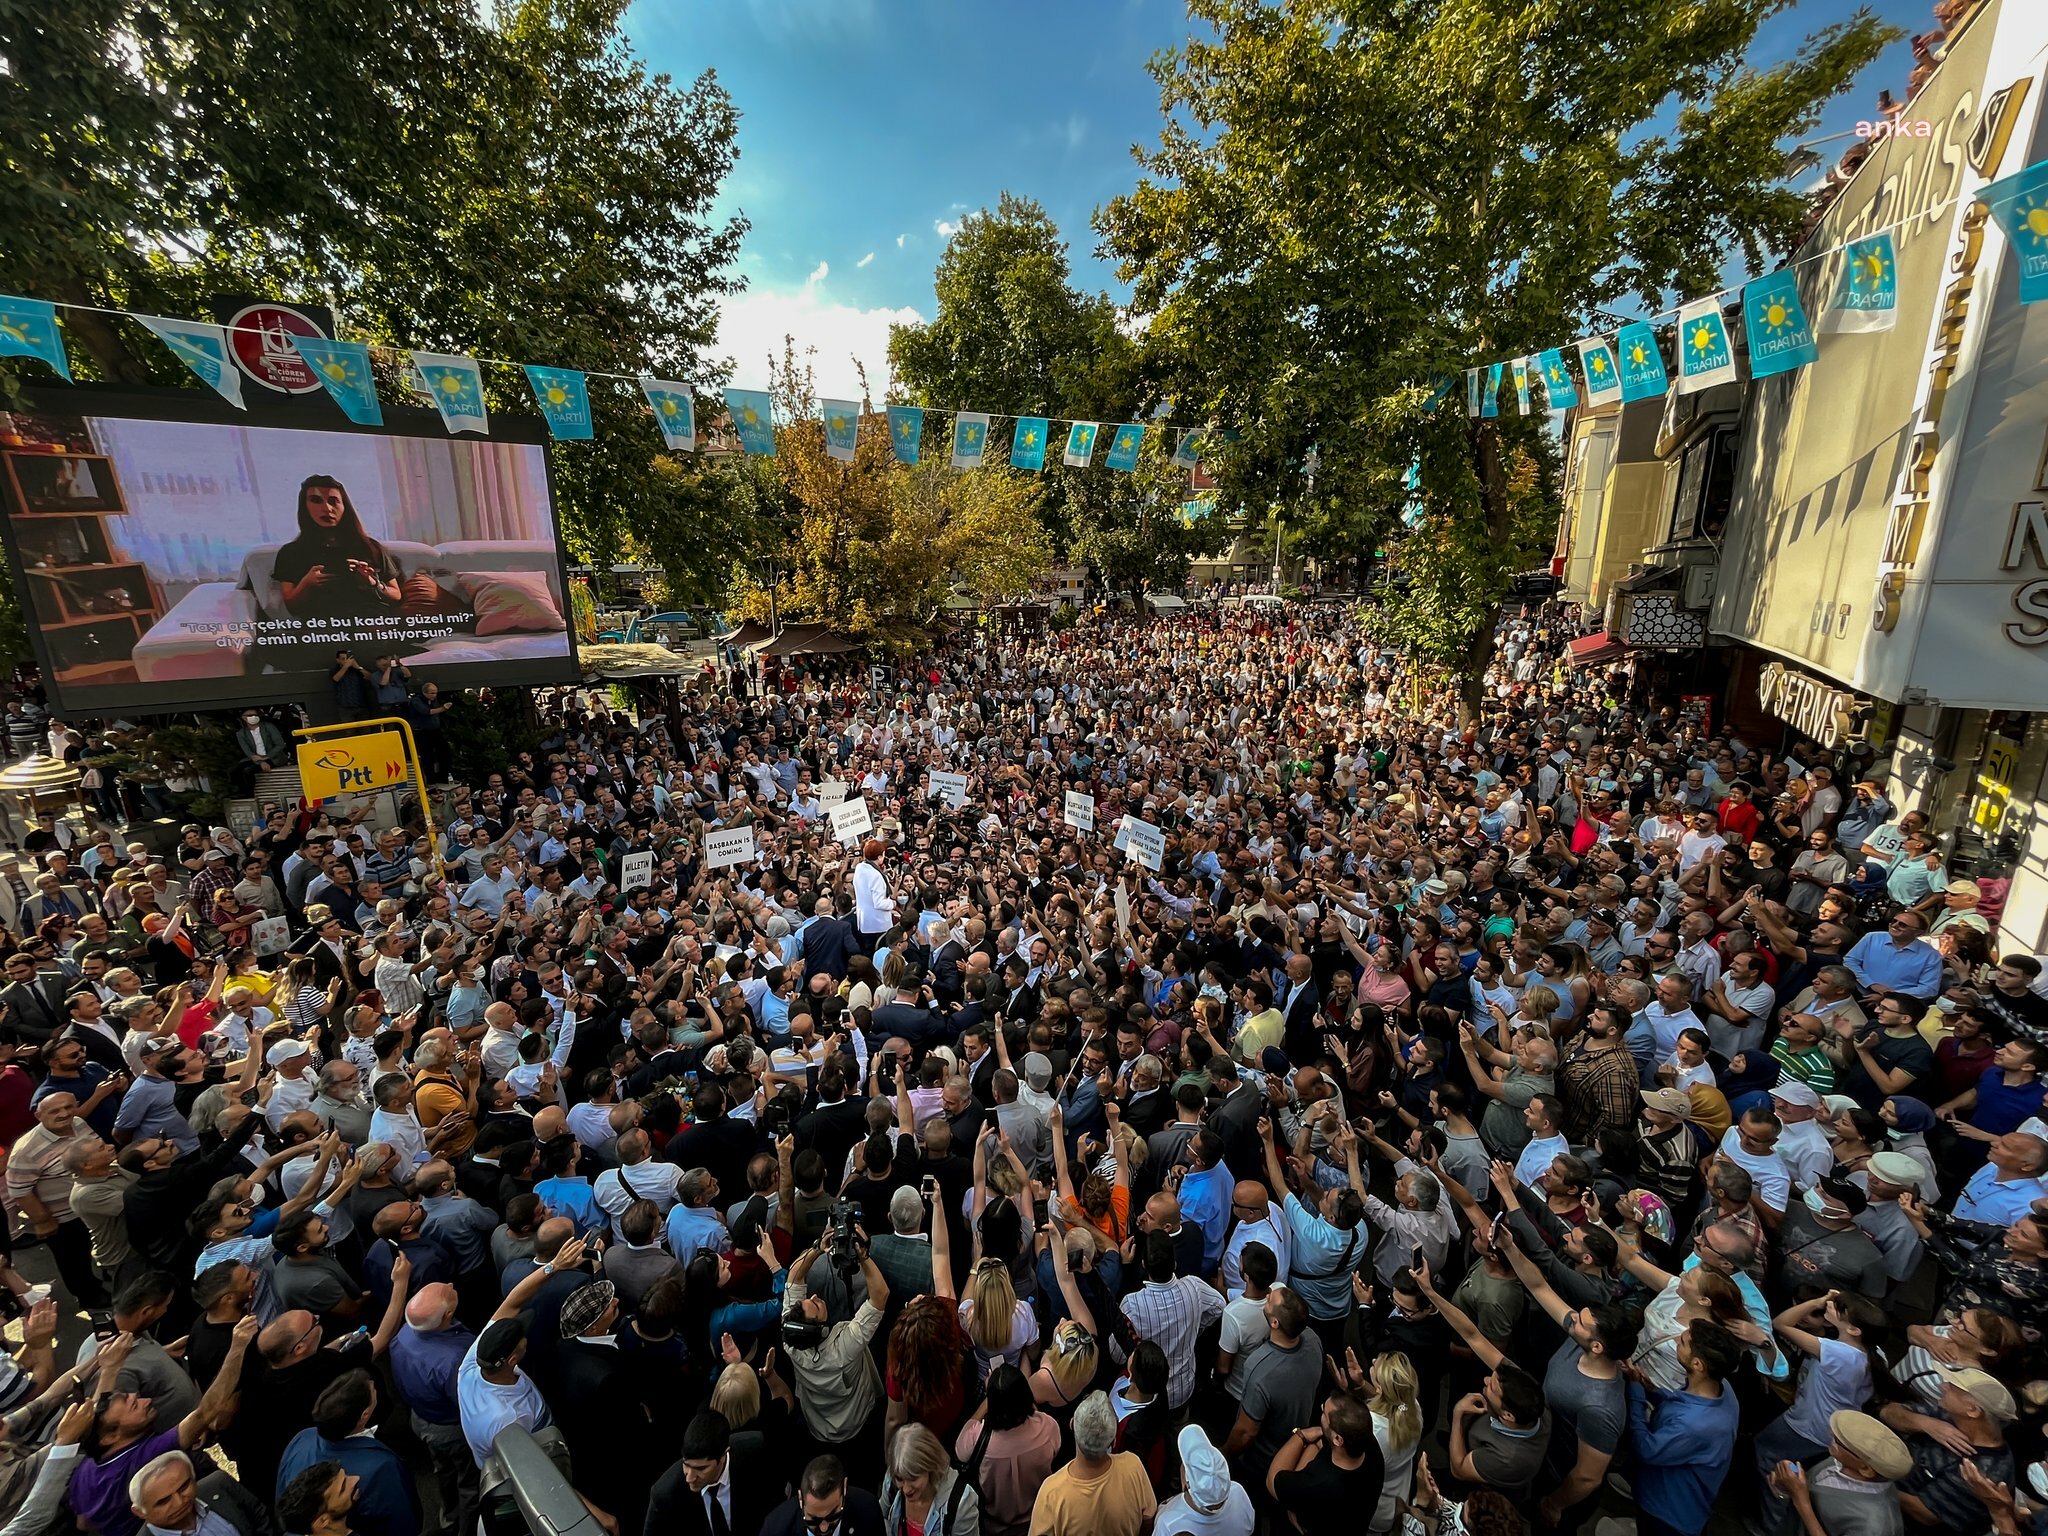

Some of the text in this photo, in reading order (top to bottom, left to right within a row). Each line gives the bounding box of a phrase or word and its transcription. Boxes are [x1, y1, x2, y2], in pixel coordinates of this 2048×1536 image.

[553, 412, 583, 423] PARTİ
[670, 424, 691, 437] ARTİ
[228, 618, 302, 635] gerçekte
[306, 616, 326, 630] de
[331, 616, 351, 628] bu
[354, 613, 401, 627] kadar
[406, 613, 443, 628] güzel
[216, 626, 454, 650] diye emin olmak mı istiyorsun?
[871, 666, 885, 690] P
[1773, 671, 1844, 749] SETRMS
[338, 765, 374, 790] Ptt
[1985, 749, 2012, 788] 50
[708, 838, 743, 851] BAŞBAKAN
[626, 873, 646, 885] UMUDU
